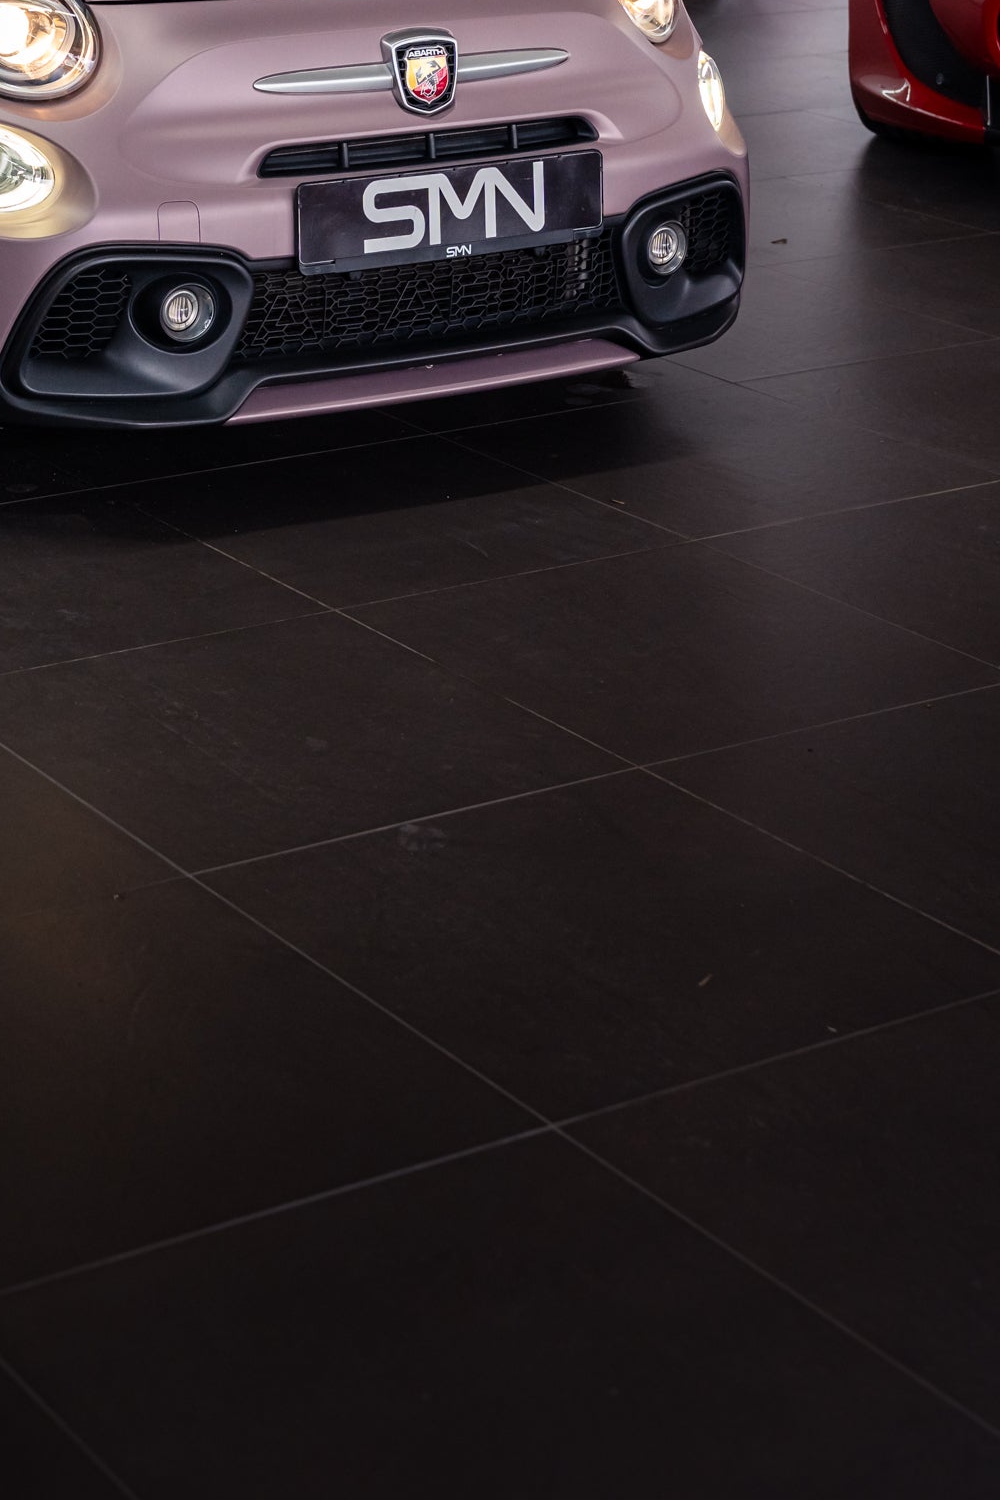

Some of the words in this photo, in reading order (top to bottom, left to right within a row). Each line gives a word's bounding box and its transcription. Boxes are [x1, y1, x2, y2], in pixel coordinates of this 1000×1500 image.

[408, 49, 444, 58] ABARTH
[362, 161, 545, 254] SMN
[446, 244, 472, 258] SMN
